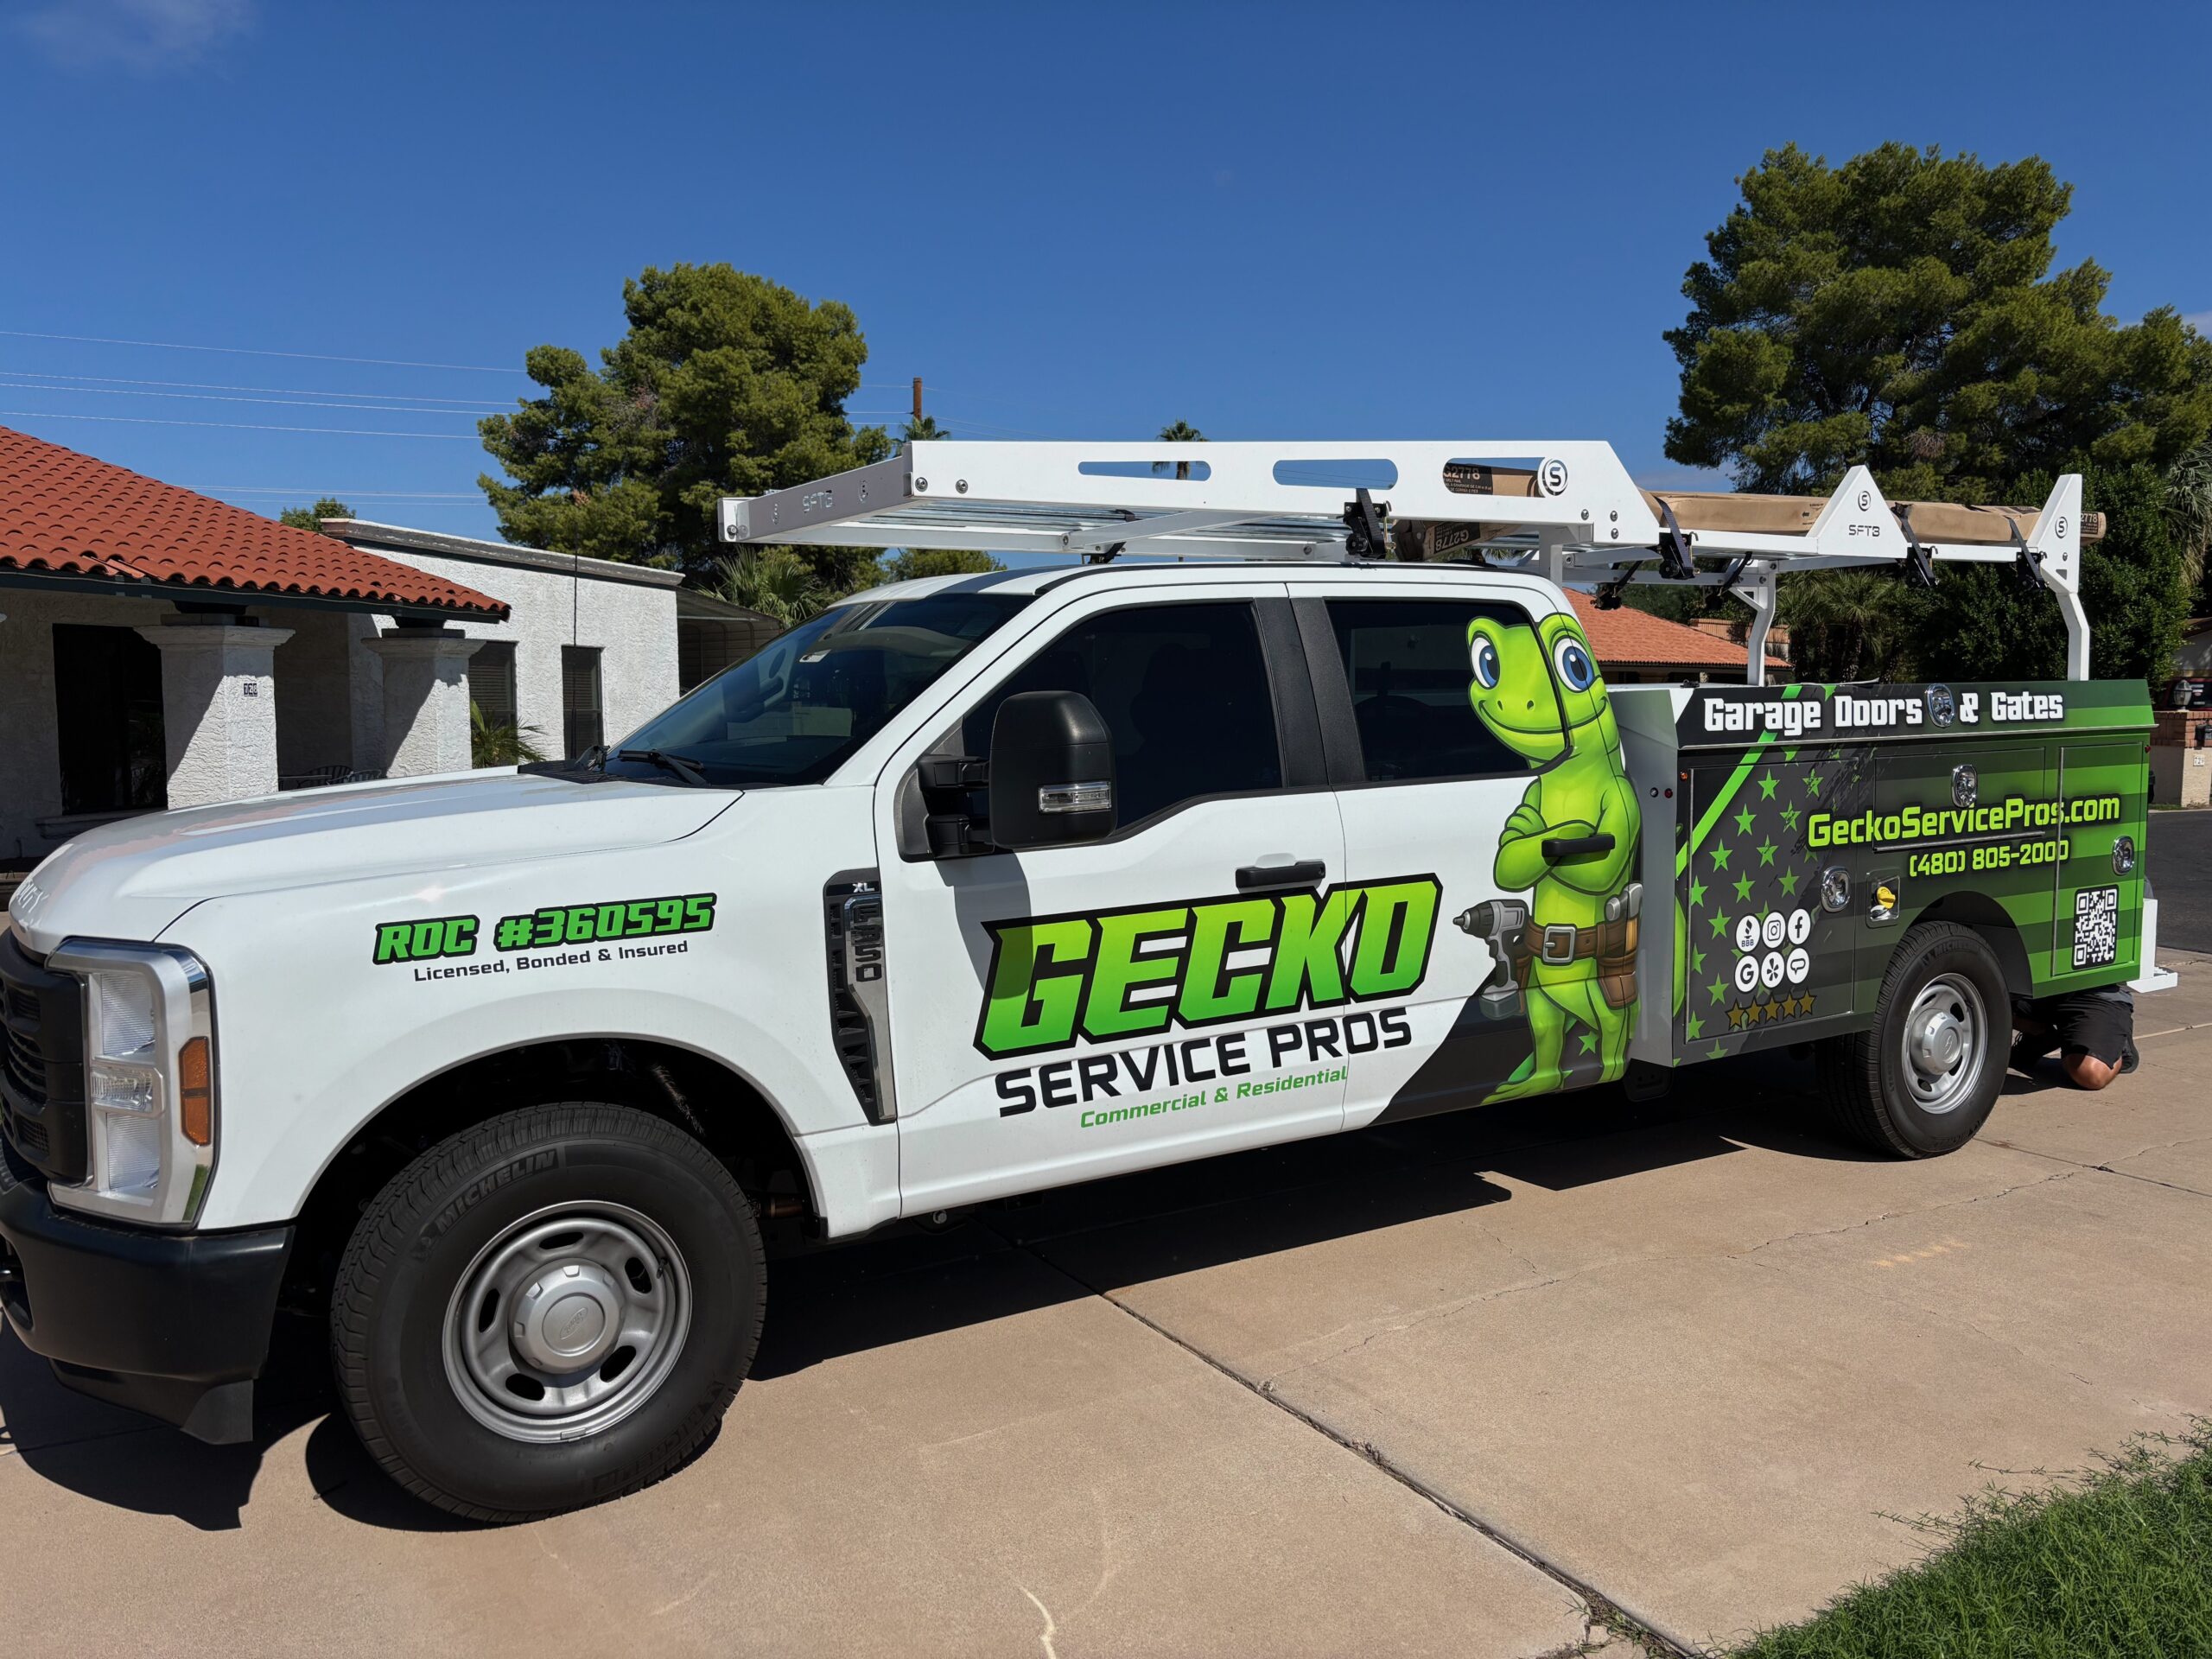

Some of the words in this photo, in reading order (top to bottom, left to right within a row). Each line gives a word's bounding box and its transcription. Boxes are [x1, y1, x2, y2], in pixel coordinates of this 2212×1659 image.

[1435, 529, 1469, 551] G2778
[1703, 698, 1821, 736] Garage
[1834, 695, 1923, 728] Doors
[1959, 692, 1979, 723] &
[1990, 690, 2064, 721] Gates
[1808, 797, 2120, 848] GeckoServicePros.com
[1909, 850, 1966, 877] (480)
[1972, 839, 2070, 871] 805-2000
[852, 881, 875, 893] XL
[374, 916, 480, 963] ROC
[494, 893, 716, 951] #360595
[414, 960, 511, 982] Licensed,
[517, 950, 591, 970] Bonded
[598, 948, 613, 962] &
[619, 940, 689, 959] Insured
[976, 874, 1441, 1058] GECKO
[995, 1033, 1251, 1117] SERVICE
[1267, 1007, 1412, 1069] PROS
[1080, 1090, 1207, 1128] Commercial
[1213, 1087, 1229, 1103] &
[1236, 1065, 1348, 1100] Residential
[435, 1150, 556, 1234] MICHELIN
